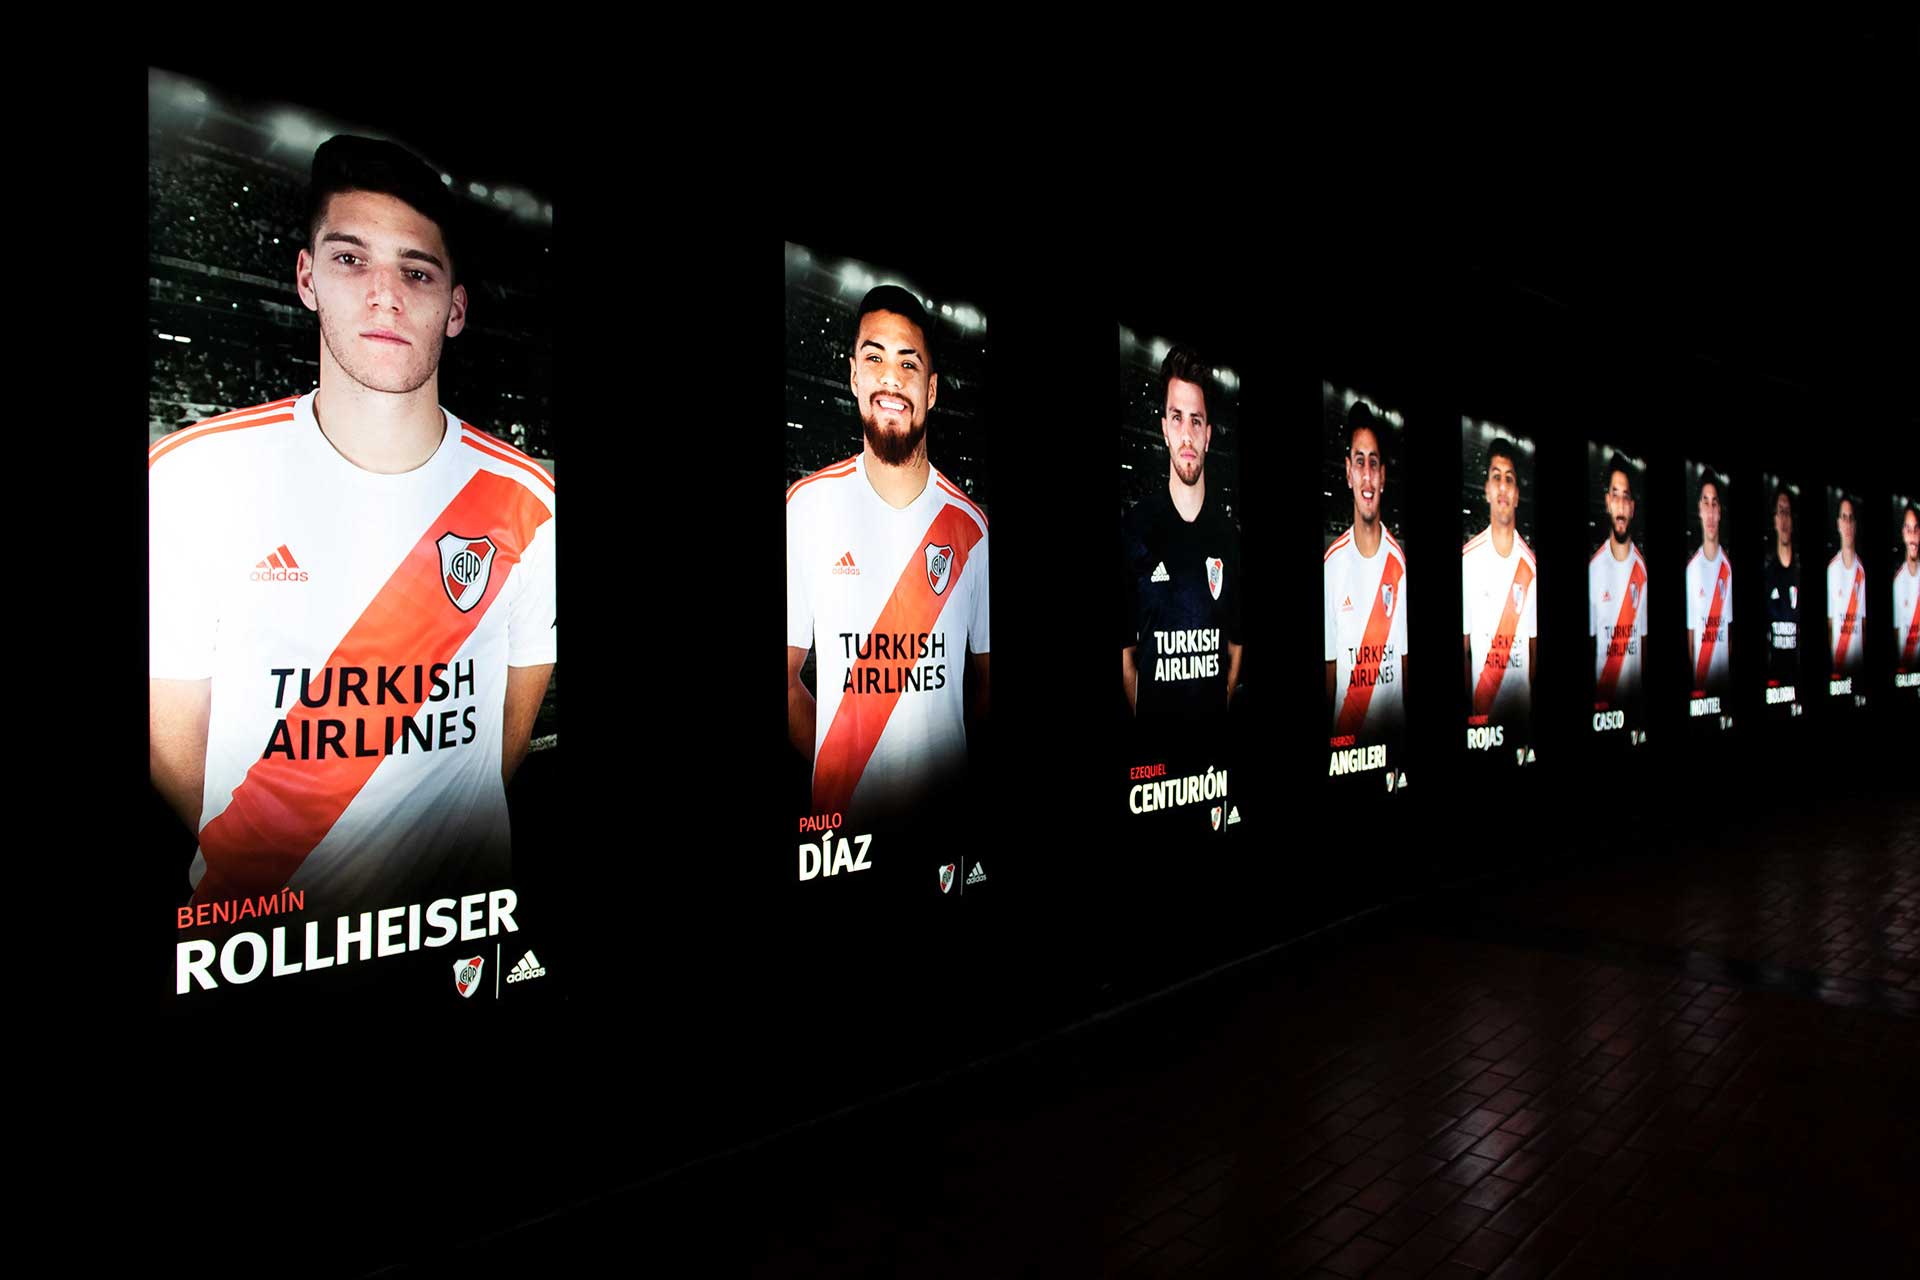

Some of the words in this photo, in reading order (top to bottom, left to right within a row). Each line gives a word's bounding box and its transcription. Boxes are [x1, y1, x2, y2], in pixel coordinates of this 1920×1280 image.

[250, 568, 308, 582] adidas
[832, 567, 860, 575] adidas
[840, 632, 945, 659] TURKISH
[1154, 628, 1220, 654] TURKISH
[1154, 653, 1219, 682] AIRLINES
[1348, 644, 1394, 665] TURKISH
[271, 659, 475, 708] TURKISH
[843, 664, 945, 694] AIRLINES
[1349, 666, 1394, 688] AIRLINES
[264, 706, 476, 760] AIRLINES
[1593, 710, 1624, 731] CASCO
[1467, 726, 1503, 751] ROJAS
[1131, 764, 1166, 780] EZEQUIEL
[1329, 745, 1386, 776] ANGILERI
[1129, 765, 1227, 815] CENTURIÓN
[799, 813, 842, 832] PAULO
[799, 830, 872, 881] DÍAZ
[966, 874, 986, 885] adidas
[178, 888, 305, 929] BENJAMÍN
[176, 888, 519, 995] ROLLHEISER
[507, 966, 546, 983] adidas
